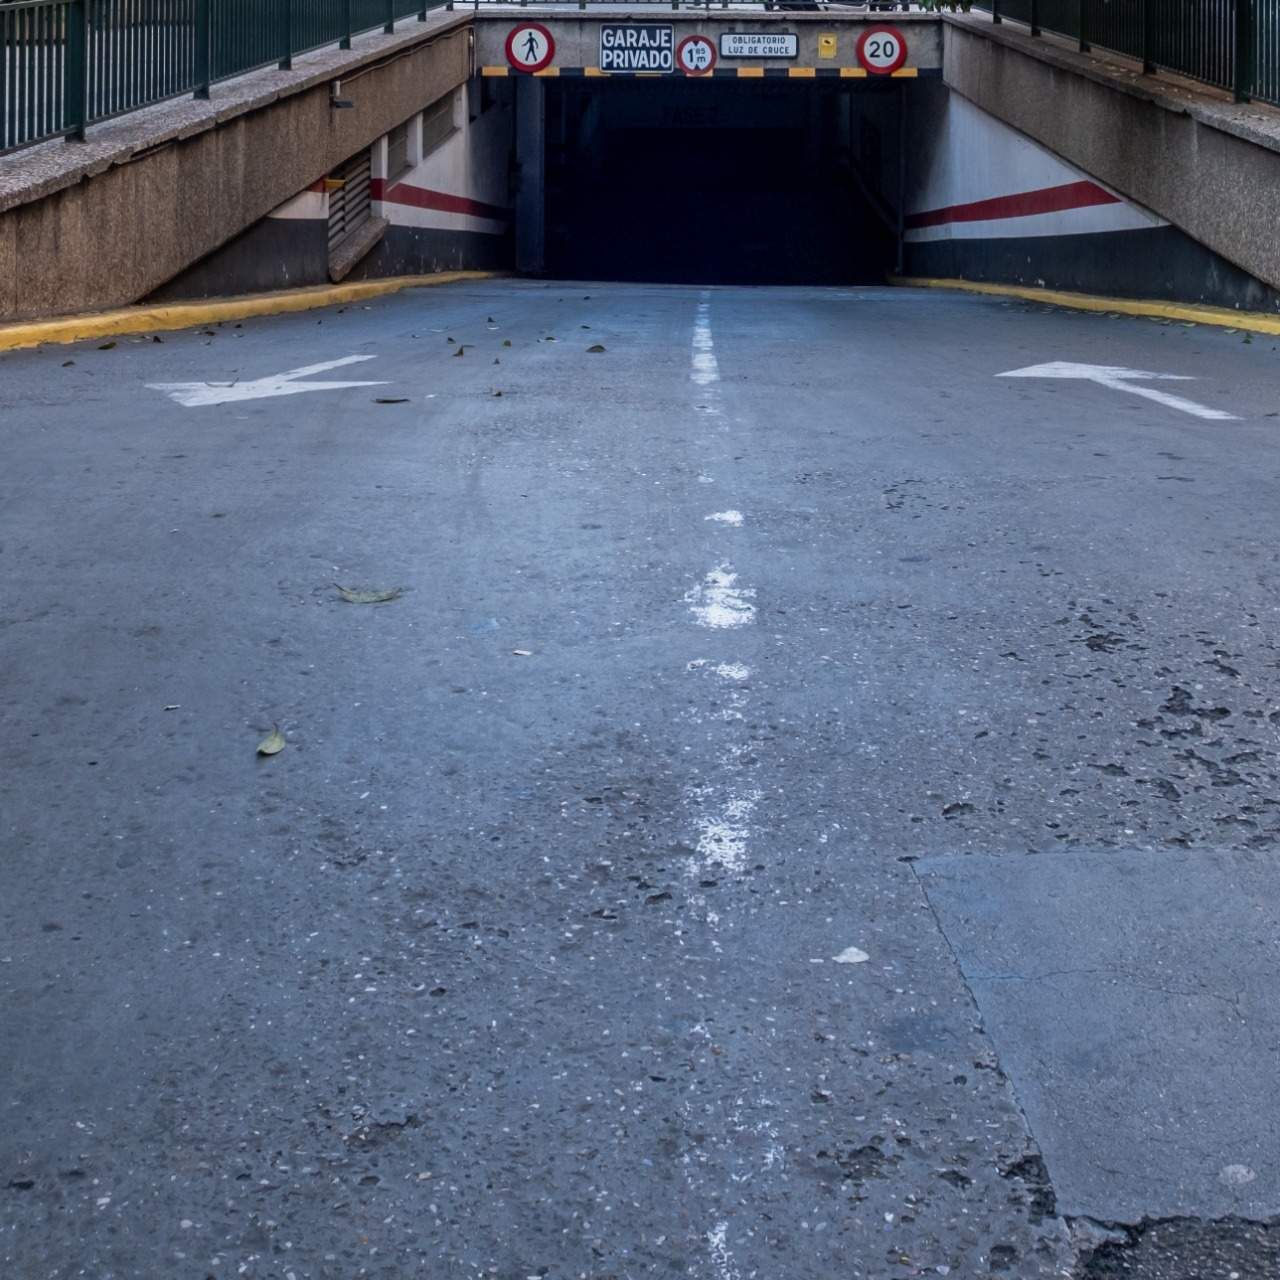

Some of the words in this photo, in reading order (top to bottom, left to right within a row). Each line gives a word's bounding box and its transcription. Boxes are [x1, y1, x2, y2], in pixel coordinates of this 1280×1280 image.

[602, 29, 671, 48] GARAJE
[733, 36, 786, 44] OBLIGATORIO
[728, 46, 743, 54] LUZ
[748, 46, 757, 54] DE
[762, 46, 790, 54] CRUCE
[869, 40, 894, 58] 20
[602, 50, 671, 68] PRIVADO
